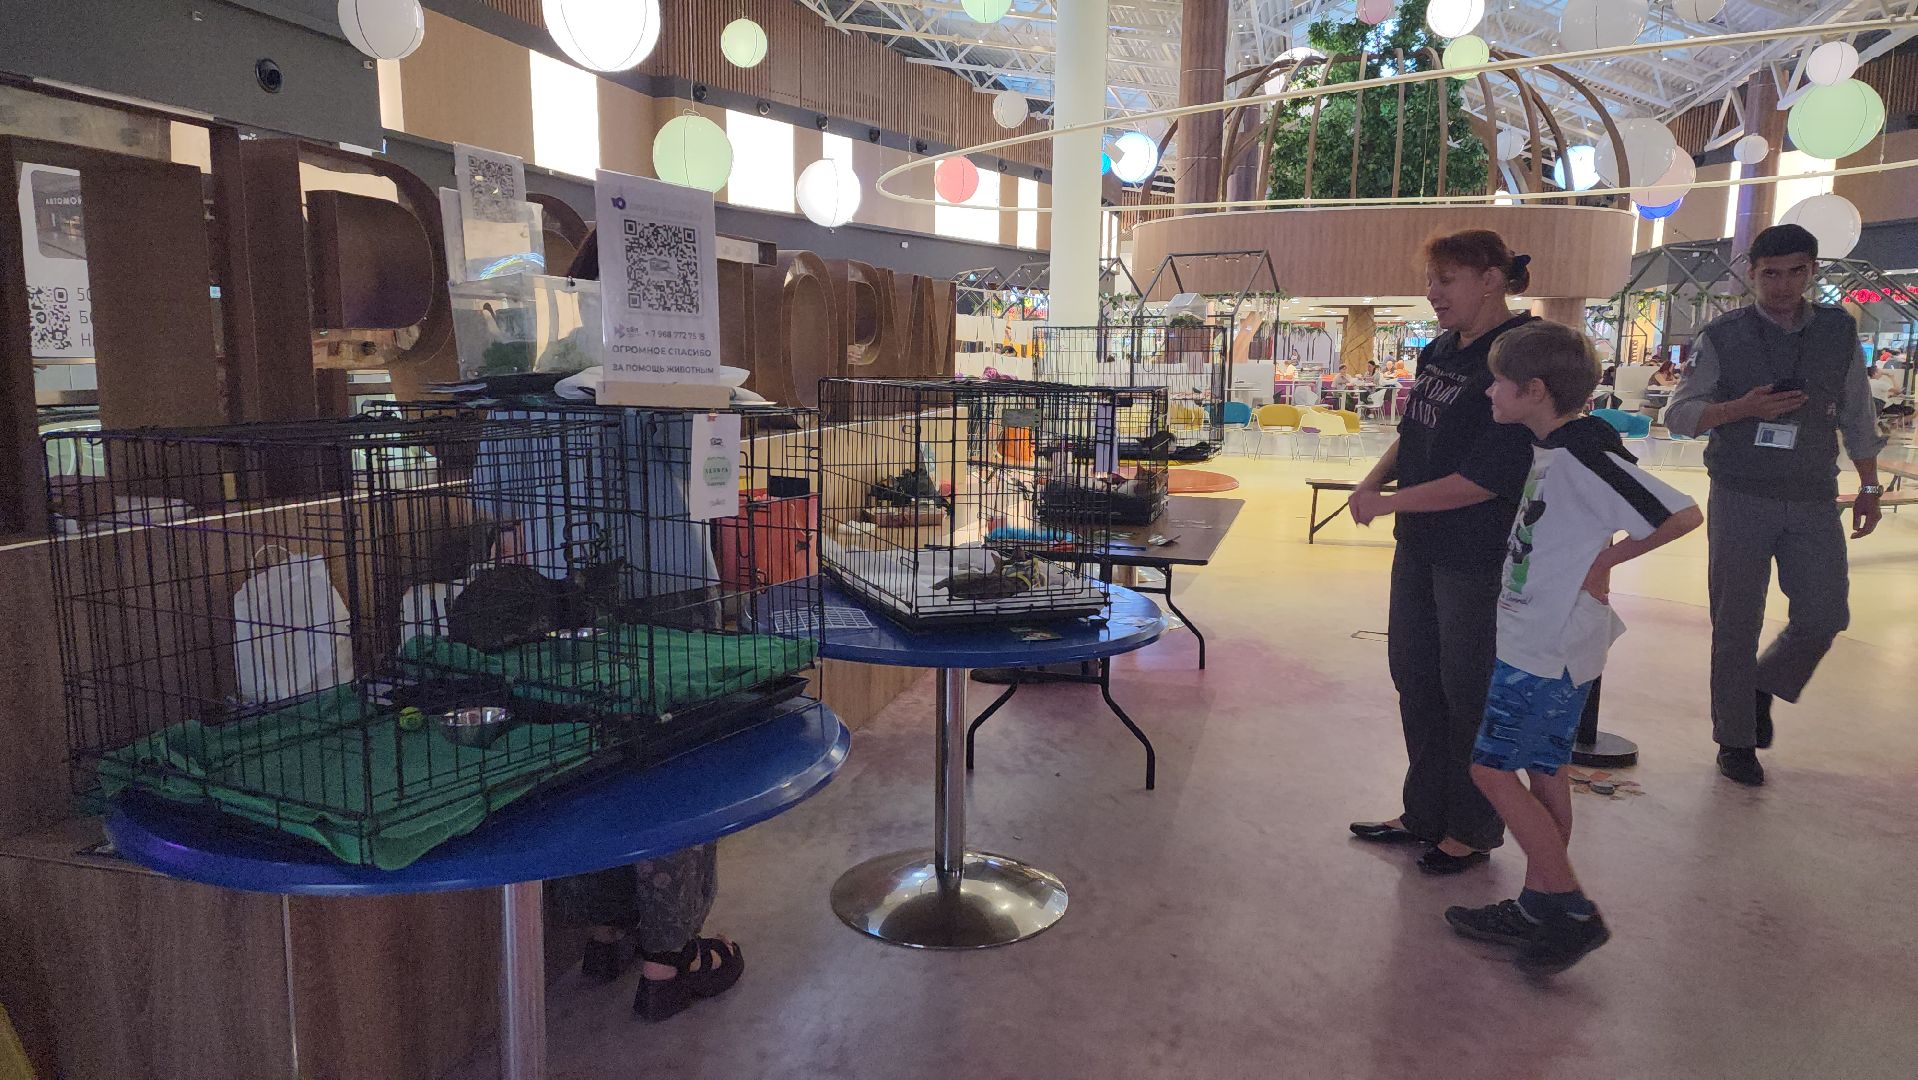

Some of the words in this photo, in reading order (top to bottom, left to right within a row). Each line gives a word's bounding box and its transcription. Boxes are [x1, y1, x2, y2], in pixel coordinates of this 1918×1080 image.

[612, 344, 666, 355] ОГРОМНОЕ
[668, 347, 712, 357] СПАСИБО
[612, 363, 624, 371] ЗА
[626, 364, 665, 374] ПОМОЩЬ
[666, 365, 714, 374] ЖИВОТНЫМ
